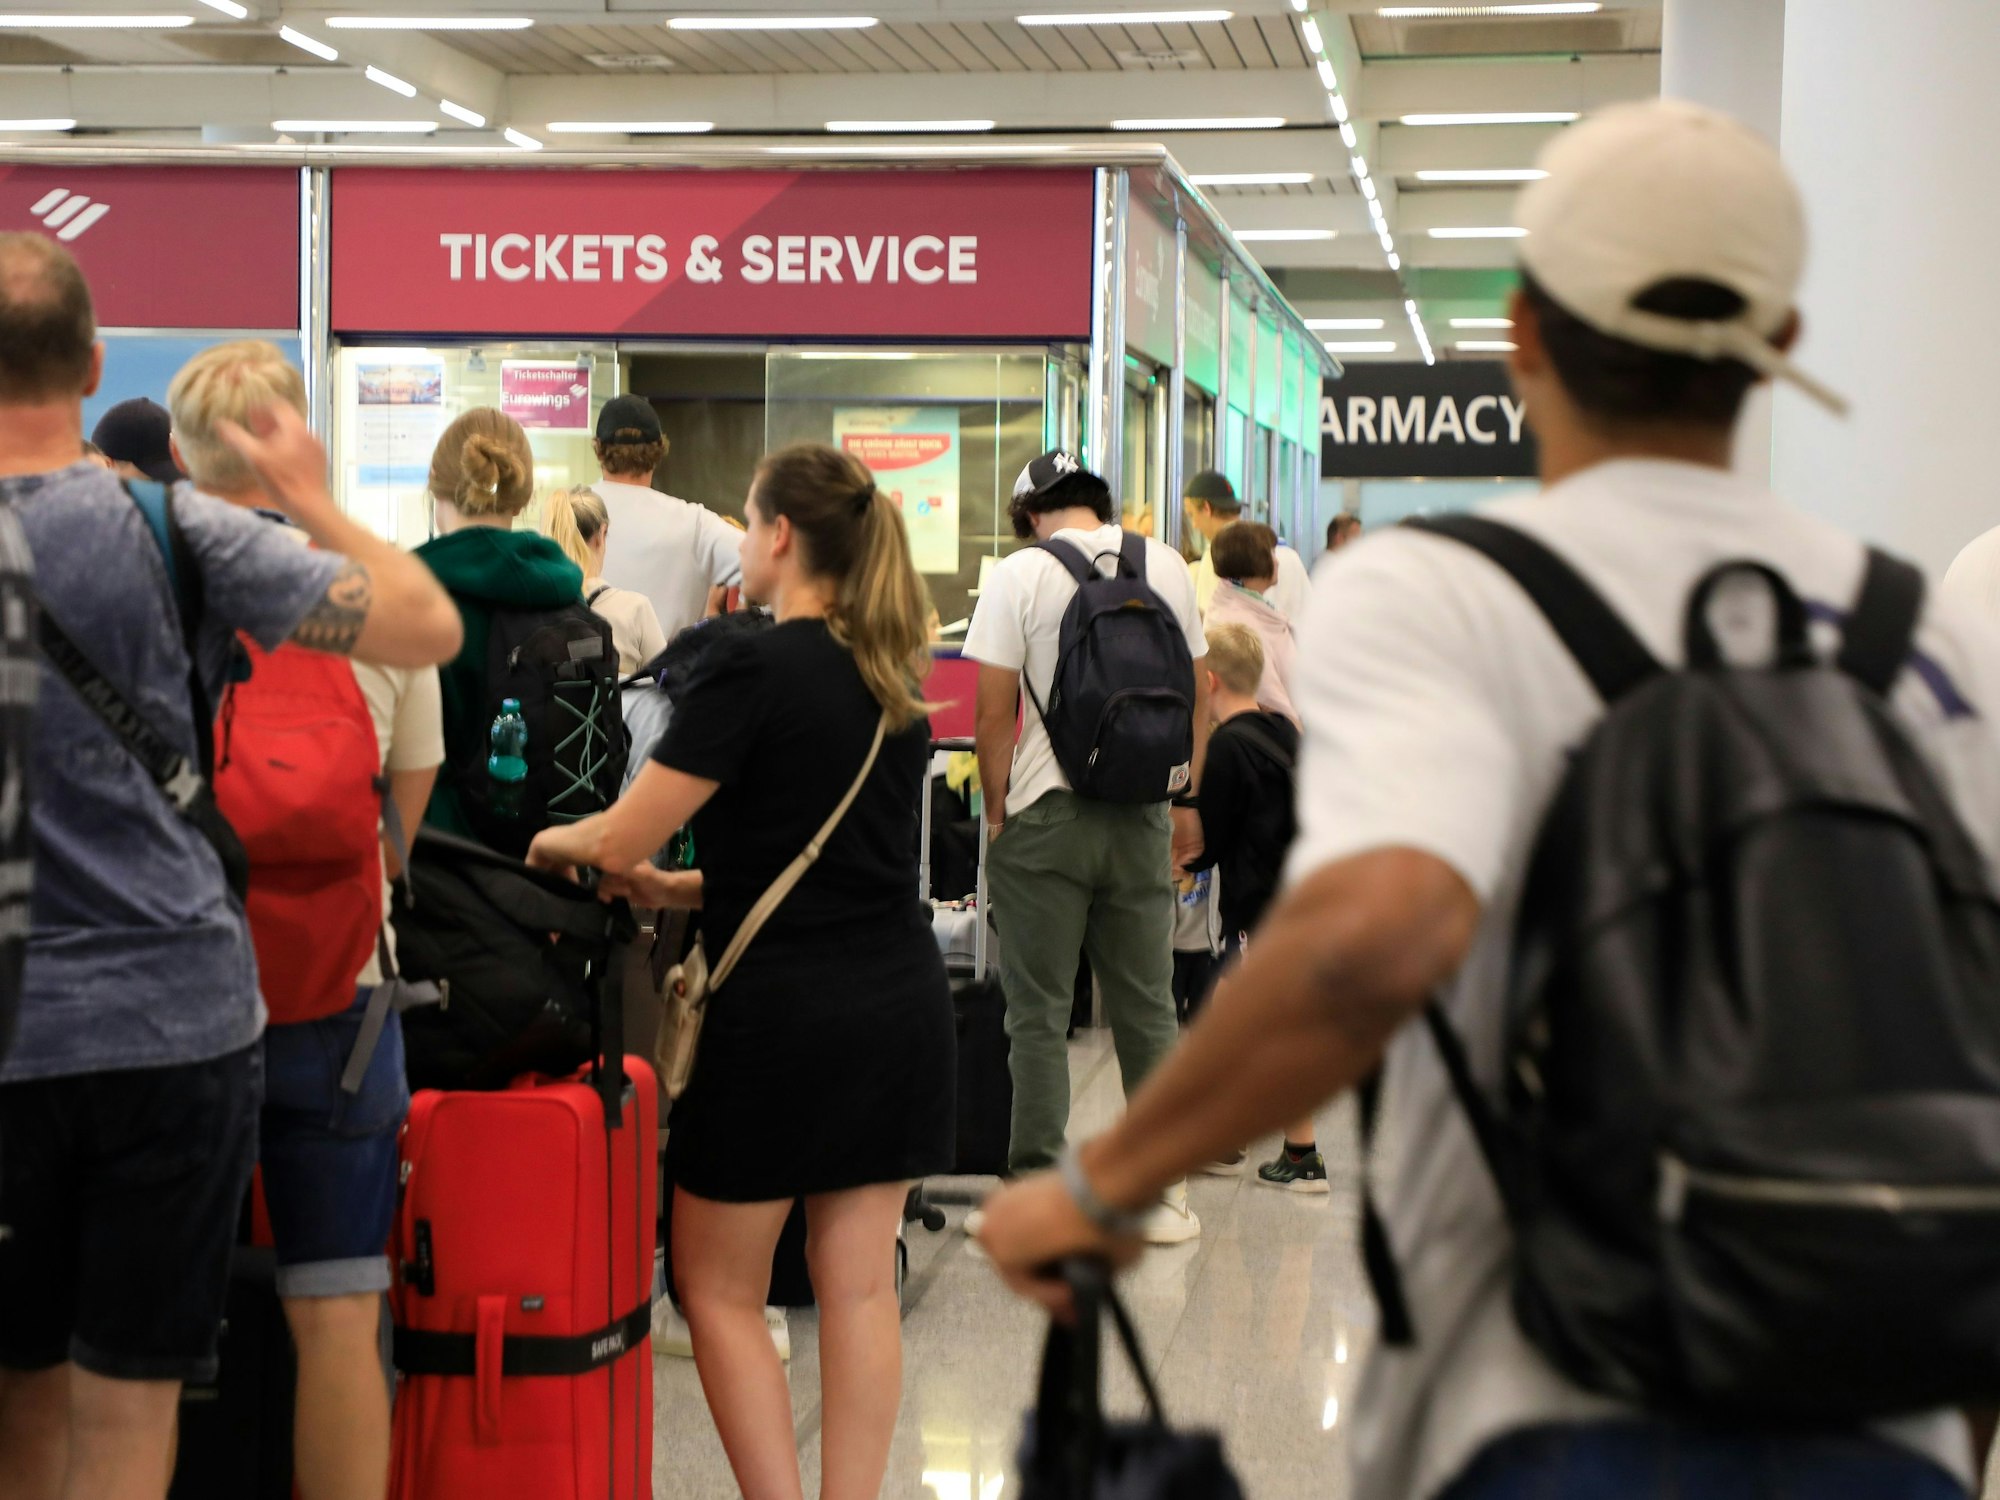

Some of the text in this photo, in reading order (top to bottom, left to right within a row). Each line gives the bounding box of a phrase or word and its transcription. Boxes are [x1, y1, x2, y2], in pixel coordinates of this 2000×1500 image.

[440, 233, 978, 284] TICKETS & SERVICE
[513, 369, 578, 382] Ticketschalter
[503, 391, 571, 410] Eurowings
[592, 1336, 609, 1361] SAFE
